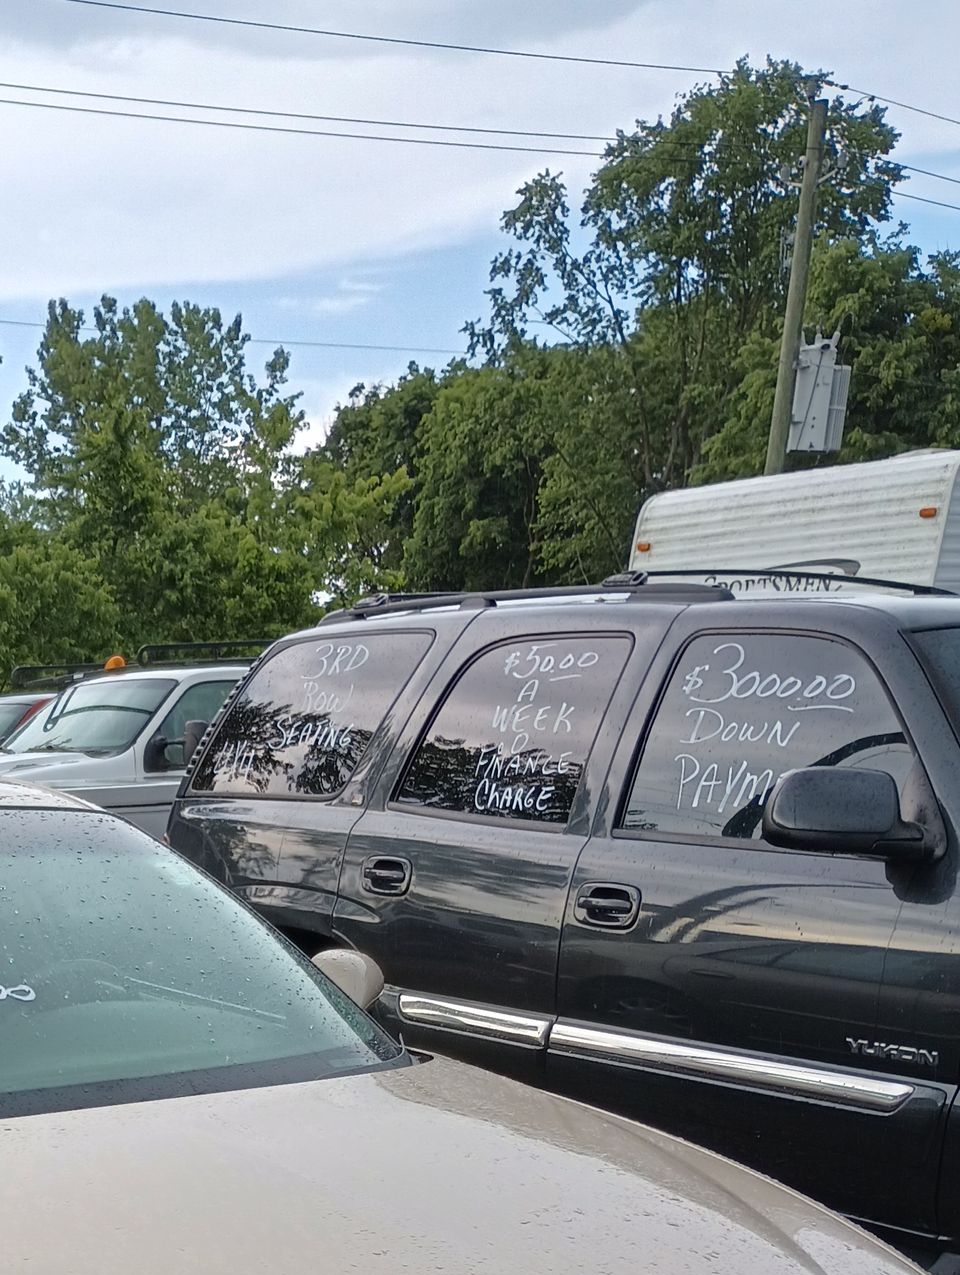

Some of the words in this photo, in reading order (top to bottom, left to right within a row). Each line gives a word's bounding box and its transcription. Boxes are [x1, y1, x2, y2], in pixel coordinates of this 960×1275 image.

[301, 644, 369, 679] 3RD
[504, 644, 598, 678] $50.00
[682, 643, 856, 703] $3000.00
[303, 681, 354, 712] ROW
[517, 679, 539, 702] A
[267, 716, 356, 750] SEATING
[492, 702, 575, 733] WEEK
[679, 707, 801, 747] DOWN
[474, 742, 573, 779] FINANCE
[845, 1036, 939, 1066] YUKON
